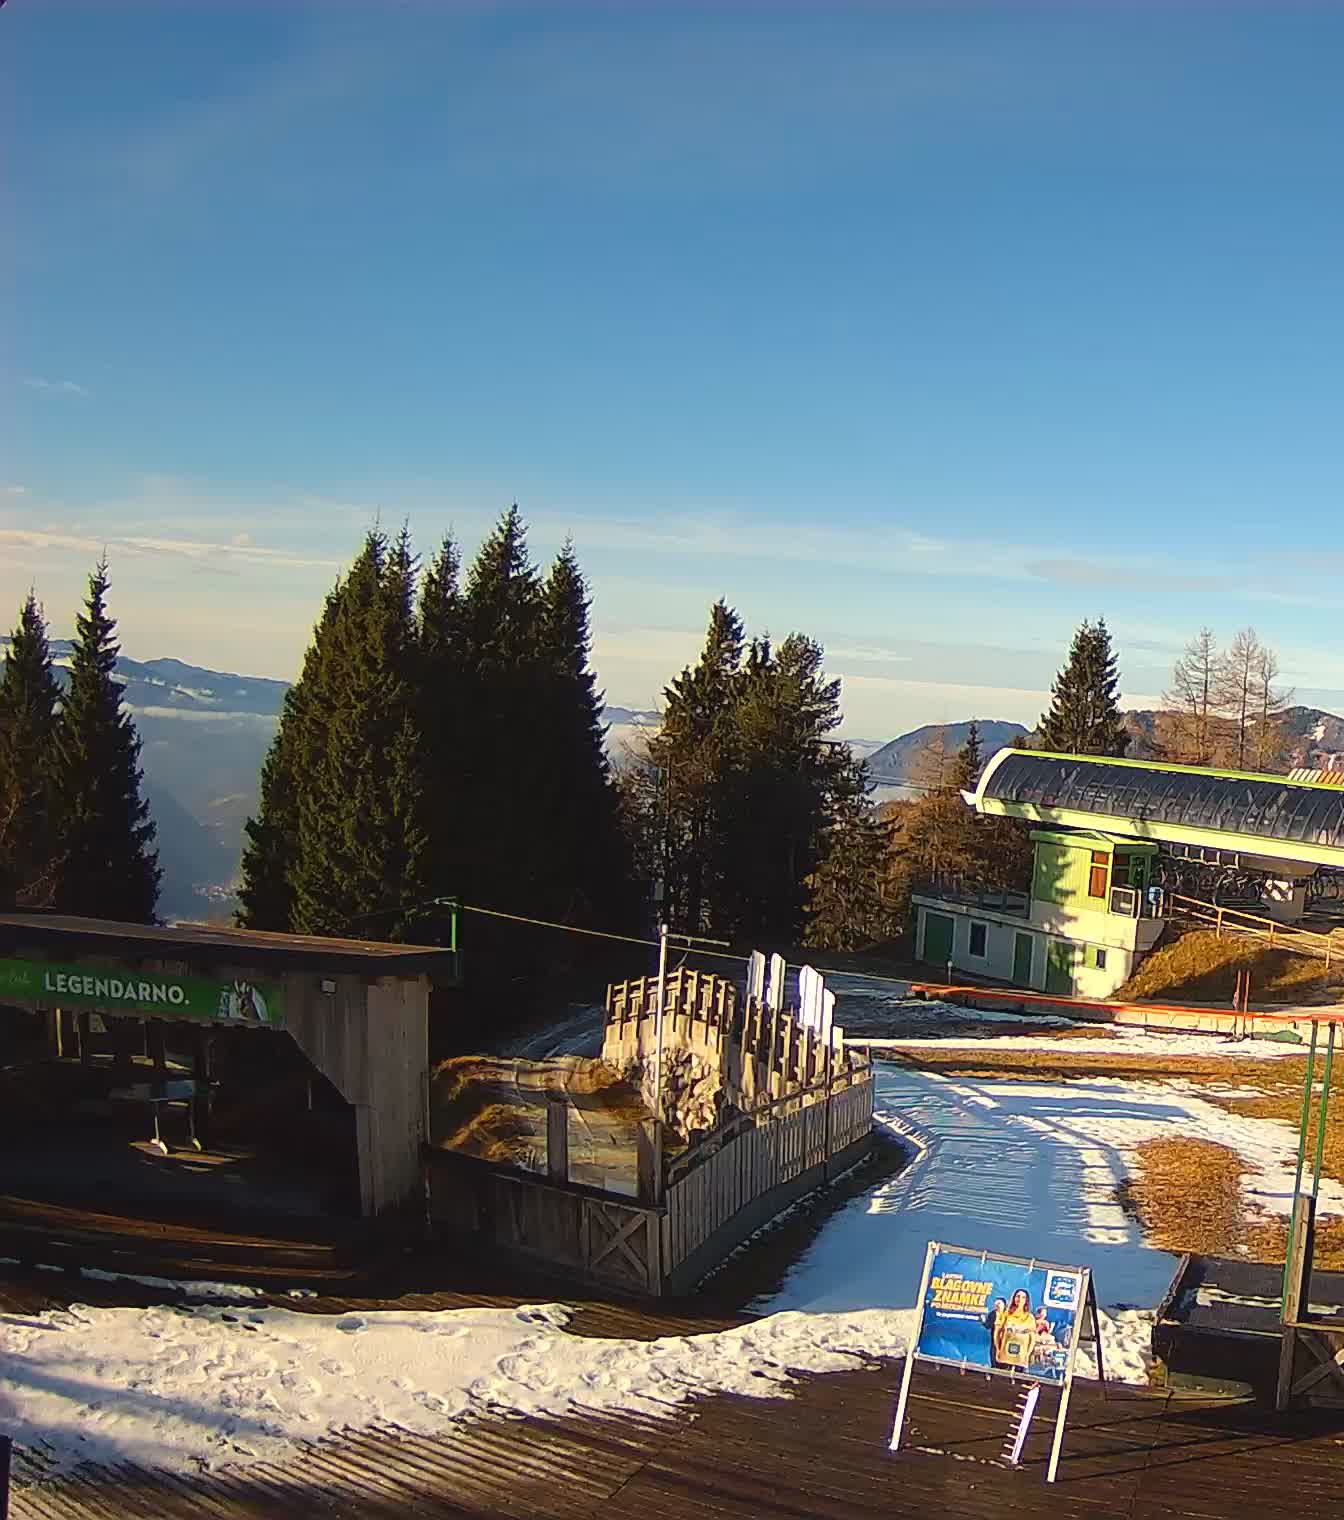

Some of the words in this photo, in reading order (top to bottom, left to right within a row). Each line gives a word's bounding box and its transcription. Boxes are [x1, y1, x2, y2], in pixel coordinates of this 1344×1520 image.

[43, 971, 191, 1005] LEGENDARNO.
[930, 1276, 993, 1295] BLAGOVNE
[932, 1289, 987, 1306] ZNAMKE
